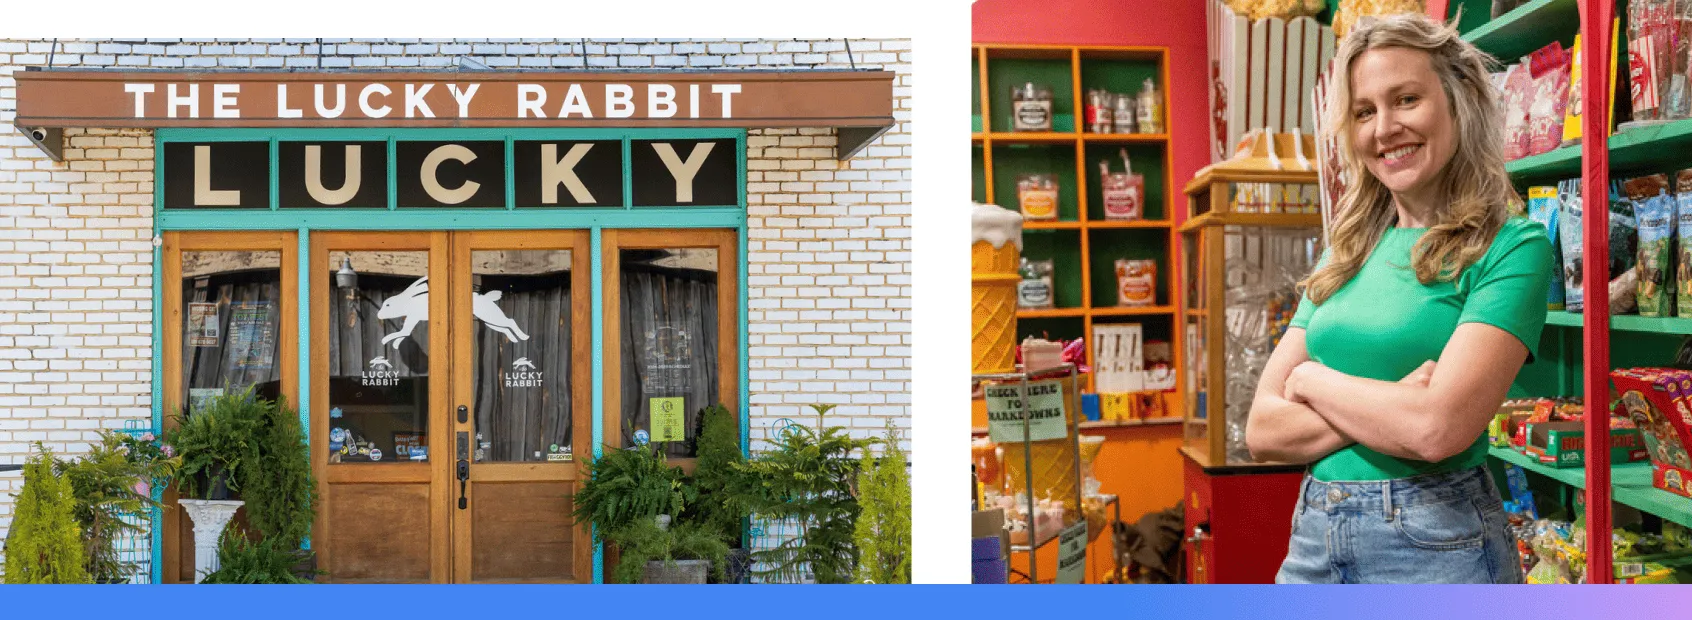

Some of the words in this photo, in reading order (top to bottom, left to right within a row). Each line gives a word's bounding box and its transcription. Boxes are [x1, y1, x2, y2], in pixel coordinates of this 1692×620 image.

[124, 83, 241, 118] THE
[277, 83, 481, 118] LUCKY
[517, 83, 742, 118] RABBIT
[193, 142, 717, 206] LUCKY
[362, 371, 400, 379] LUCKY
[505, 372, 543, 380] LUCKY
